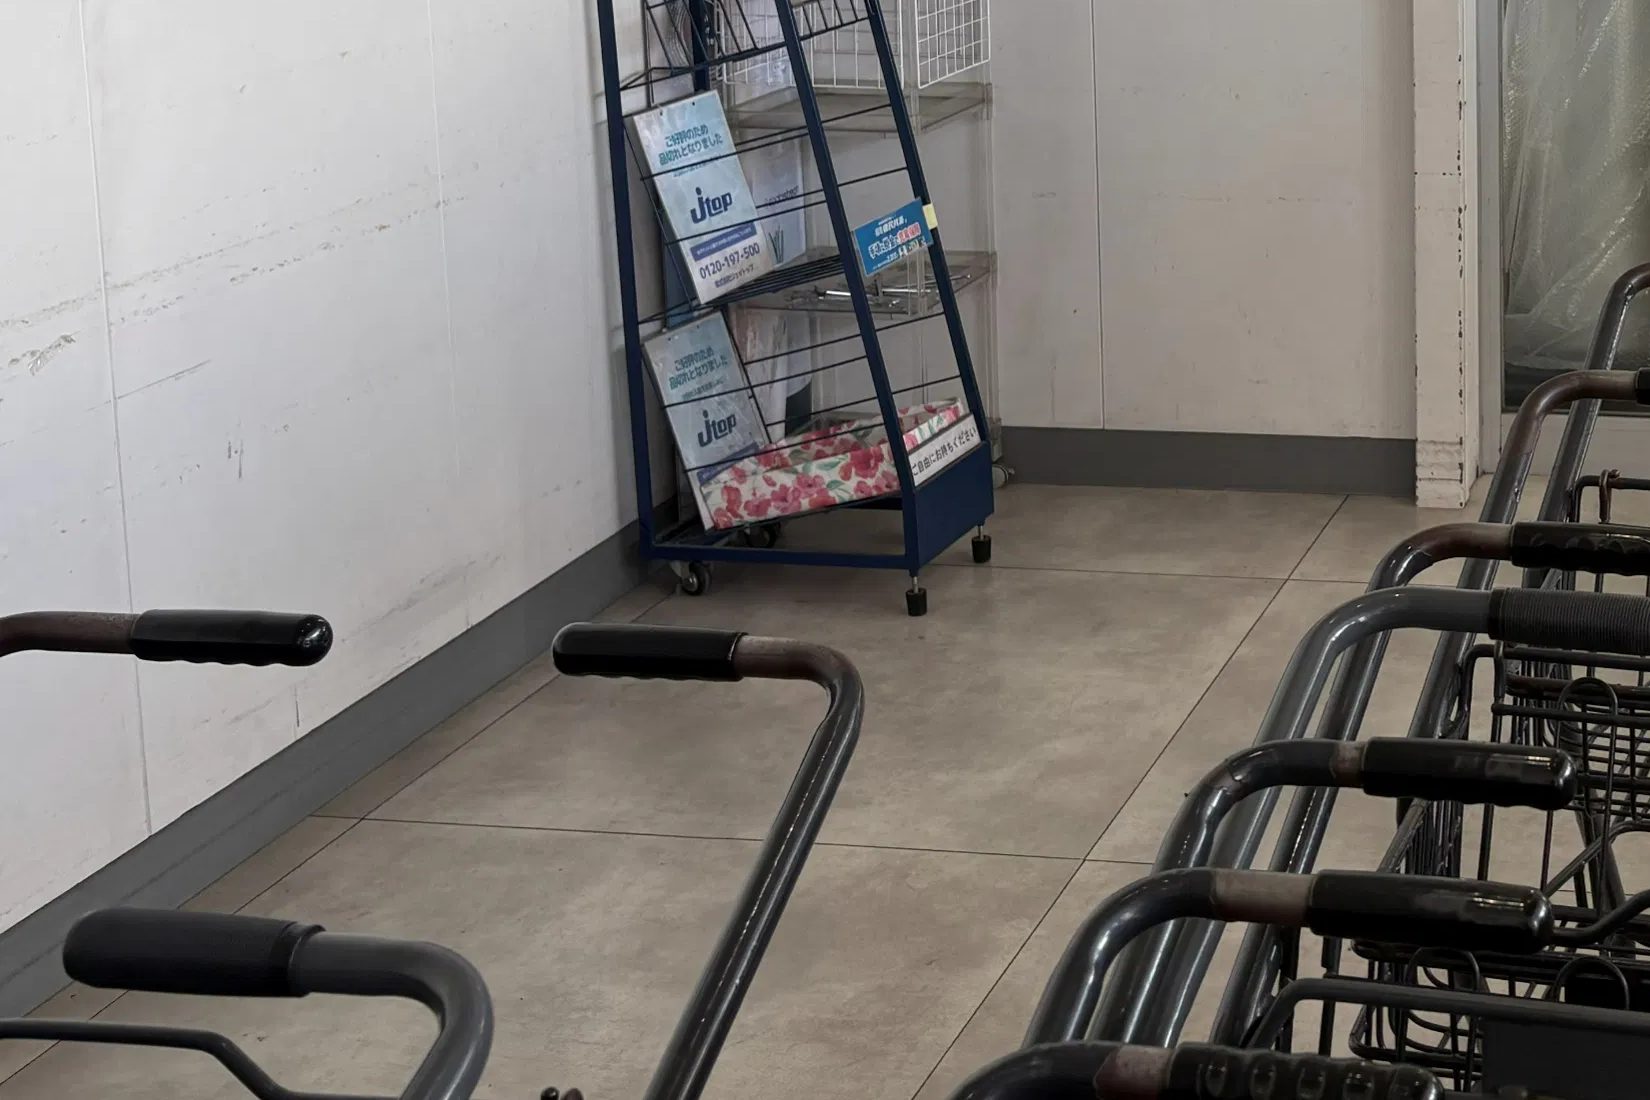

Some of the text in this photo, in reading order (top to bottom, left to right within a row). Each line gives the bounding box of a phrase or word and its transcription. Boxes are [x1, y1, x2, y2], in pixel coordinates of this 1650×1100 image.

[659, 133, 723, 166] 品切れとなりました
[700, 243, 760, 280] 0120-197-500
[911, 426, 977, 476] ご自由にお持ちください
